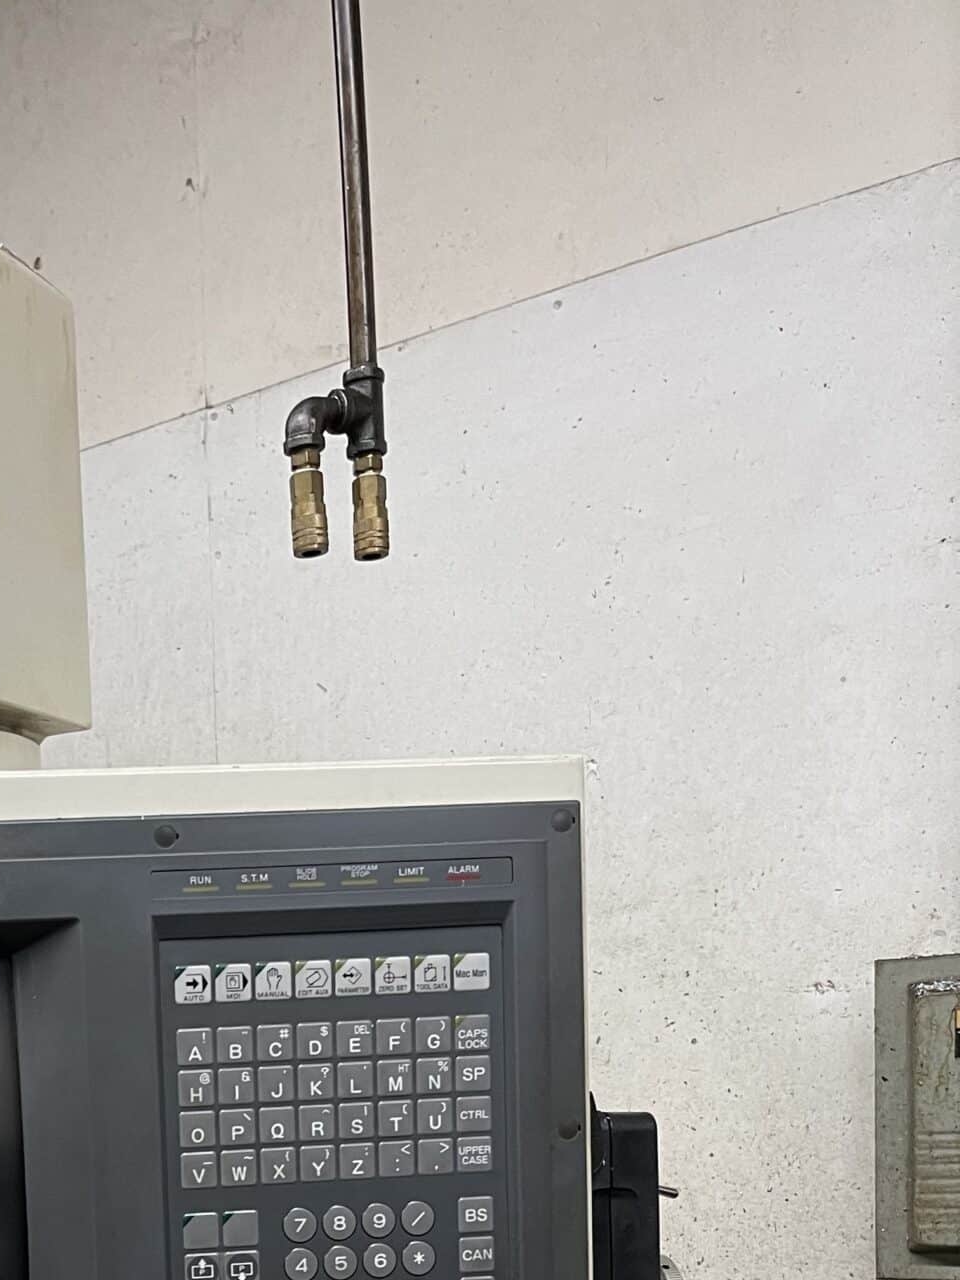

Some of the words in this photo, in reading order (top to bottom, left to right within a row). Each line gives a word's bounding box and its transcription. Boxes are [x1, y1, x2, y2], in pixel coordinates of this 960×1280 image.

[351, 870, 370, 878] STOP
[398, 866, 425, 877] LIMIT
[447, 865, 480, 874] ALARM
[190, 875, 212, 885] RUN
[455, 970, 471, 978] Mac
[471, 969, 488, 977] Man
[354, 1025, 370, 1034] DEL
[457, 1028, 488, 1039] CAPS
[309, 1040, 322, 1055] D
[349, 1038, 361, 1053] E
[389, 1036, 401, 1051] F
[427, 1034, 441, 1049] G
[458, 1039, 488, 1049] LOCK
[188, 1046, 202, 1062] A
[229, 1044, 242, 1059] B
[269, 1042, 282, 1057] C
[398, 1064, 410, 1073] HT
[462, 1067, 486, 1081] SP
[271, 1082, 283, 1098] J
[310, 1080, 322, 1096] K
[350, 1079, 362, 1094] L
[388, 1076, 403, 1092] M
[428, 1075, 441, 1090] N
[190, 1087, 203, 1103] H
[460, 1109, 489, 1120] CTRL
[311, 1121, 325, 1137] R
[351, 1119, 364, 1134] S
[389, 1117, 403, 1132] T
[429, 1115, 442, 1130] U
[191, 1128, 205, 1143] O
[231, 1125, 245, 1141] P
[270, 1123, 285, 1139] Q
[458, 1145, 491, 1156] UPPER
[351, 1160, 364, 1175] Z
[462, 1155, 489, 1165] CASE
[192, 1168, 206, 1184] V
[232, 1166, 247, 1182] W
[273, 1164, 286, 1179] X
[312, 1161, 325, 1177] Y
[373, 1213, 386, 1229] 9
[465, 1208, 488, 1222] BS
[294, 1218, 307, 1233] 7
[333, 1216, 346, 1231] 8
[374, 1253, 387, 1268] 6
[462, 1248, 493, 1261] CAN
[295, 1258, 308, 1273] 4
[334, 1256, 348, 1271] 5
